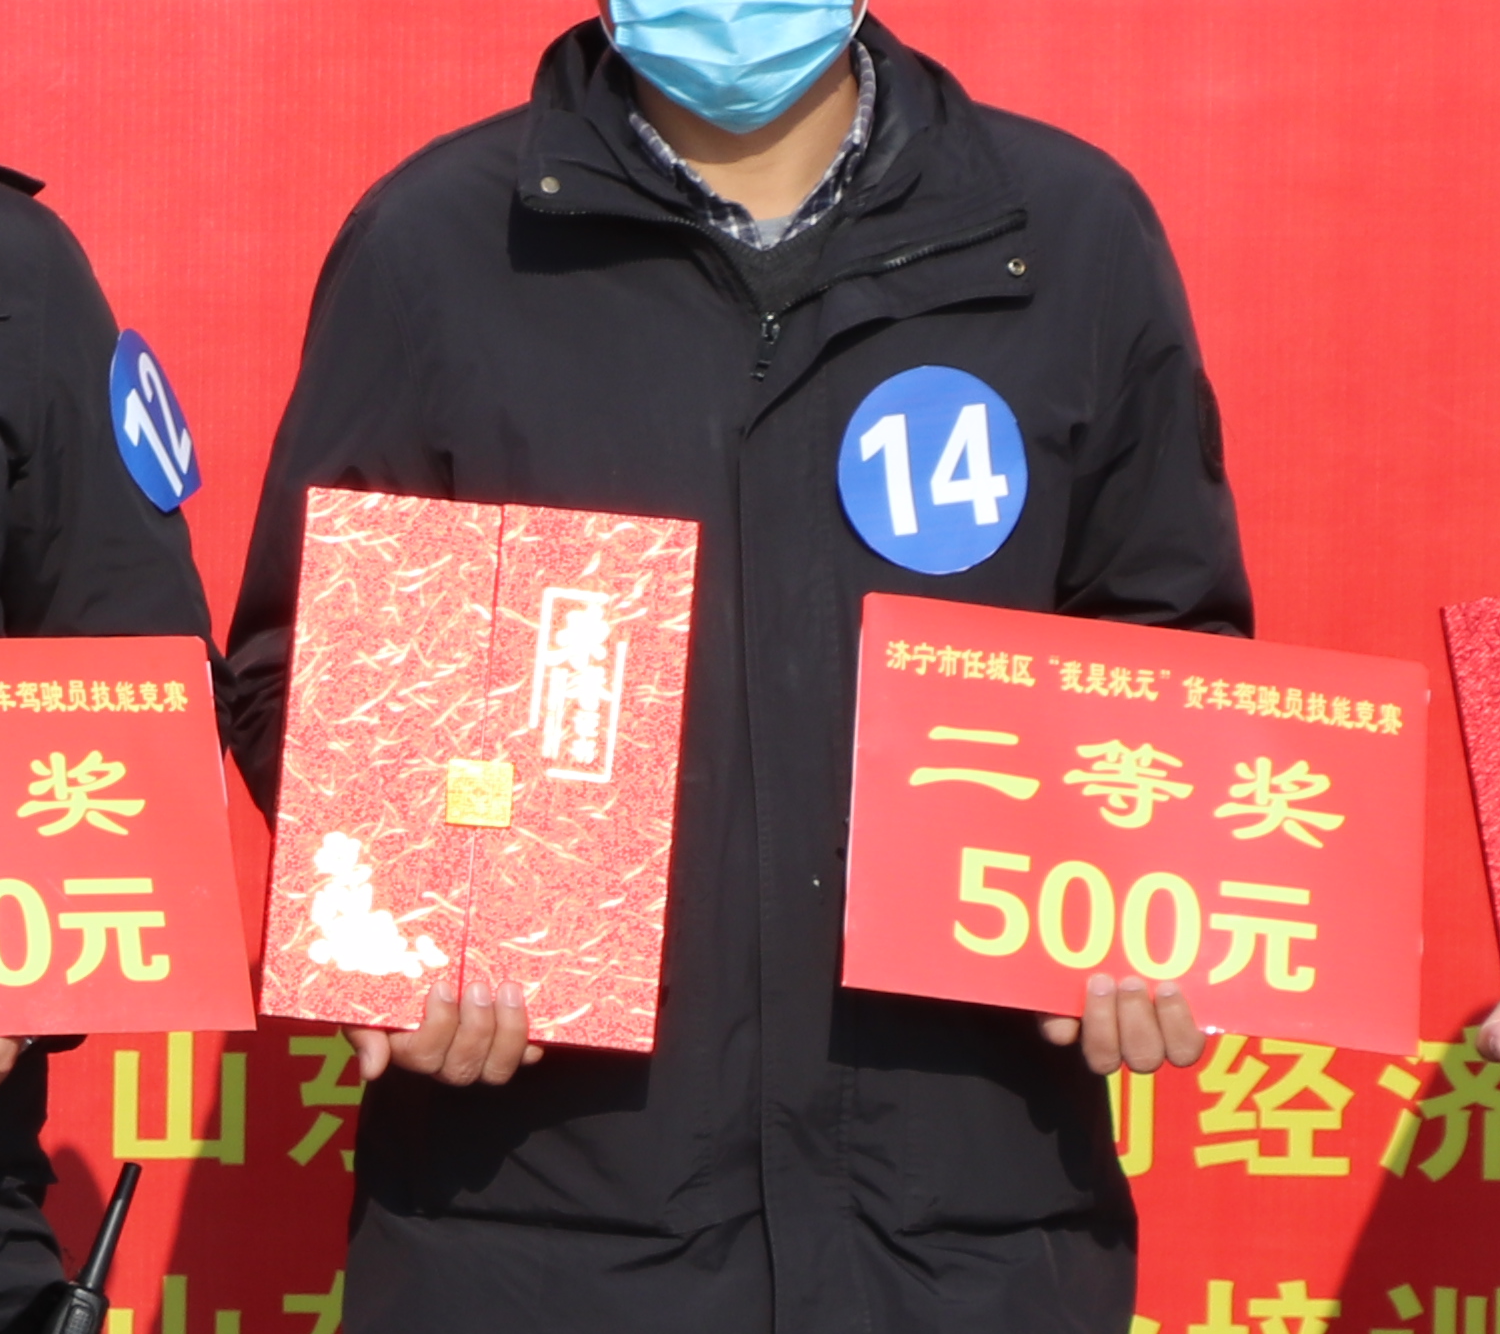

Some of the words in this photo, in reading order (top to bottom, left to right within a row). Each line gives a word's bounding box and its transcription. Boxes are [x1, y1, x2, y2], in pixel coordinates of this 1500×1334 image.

[124, 352, 192, 497] 12
[860, 403, 1009, 536] 14
[908, 725, 1346, 849] 二等奖
[953, 846, 1319, 992] 500元
